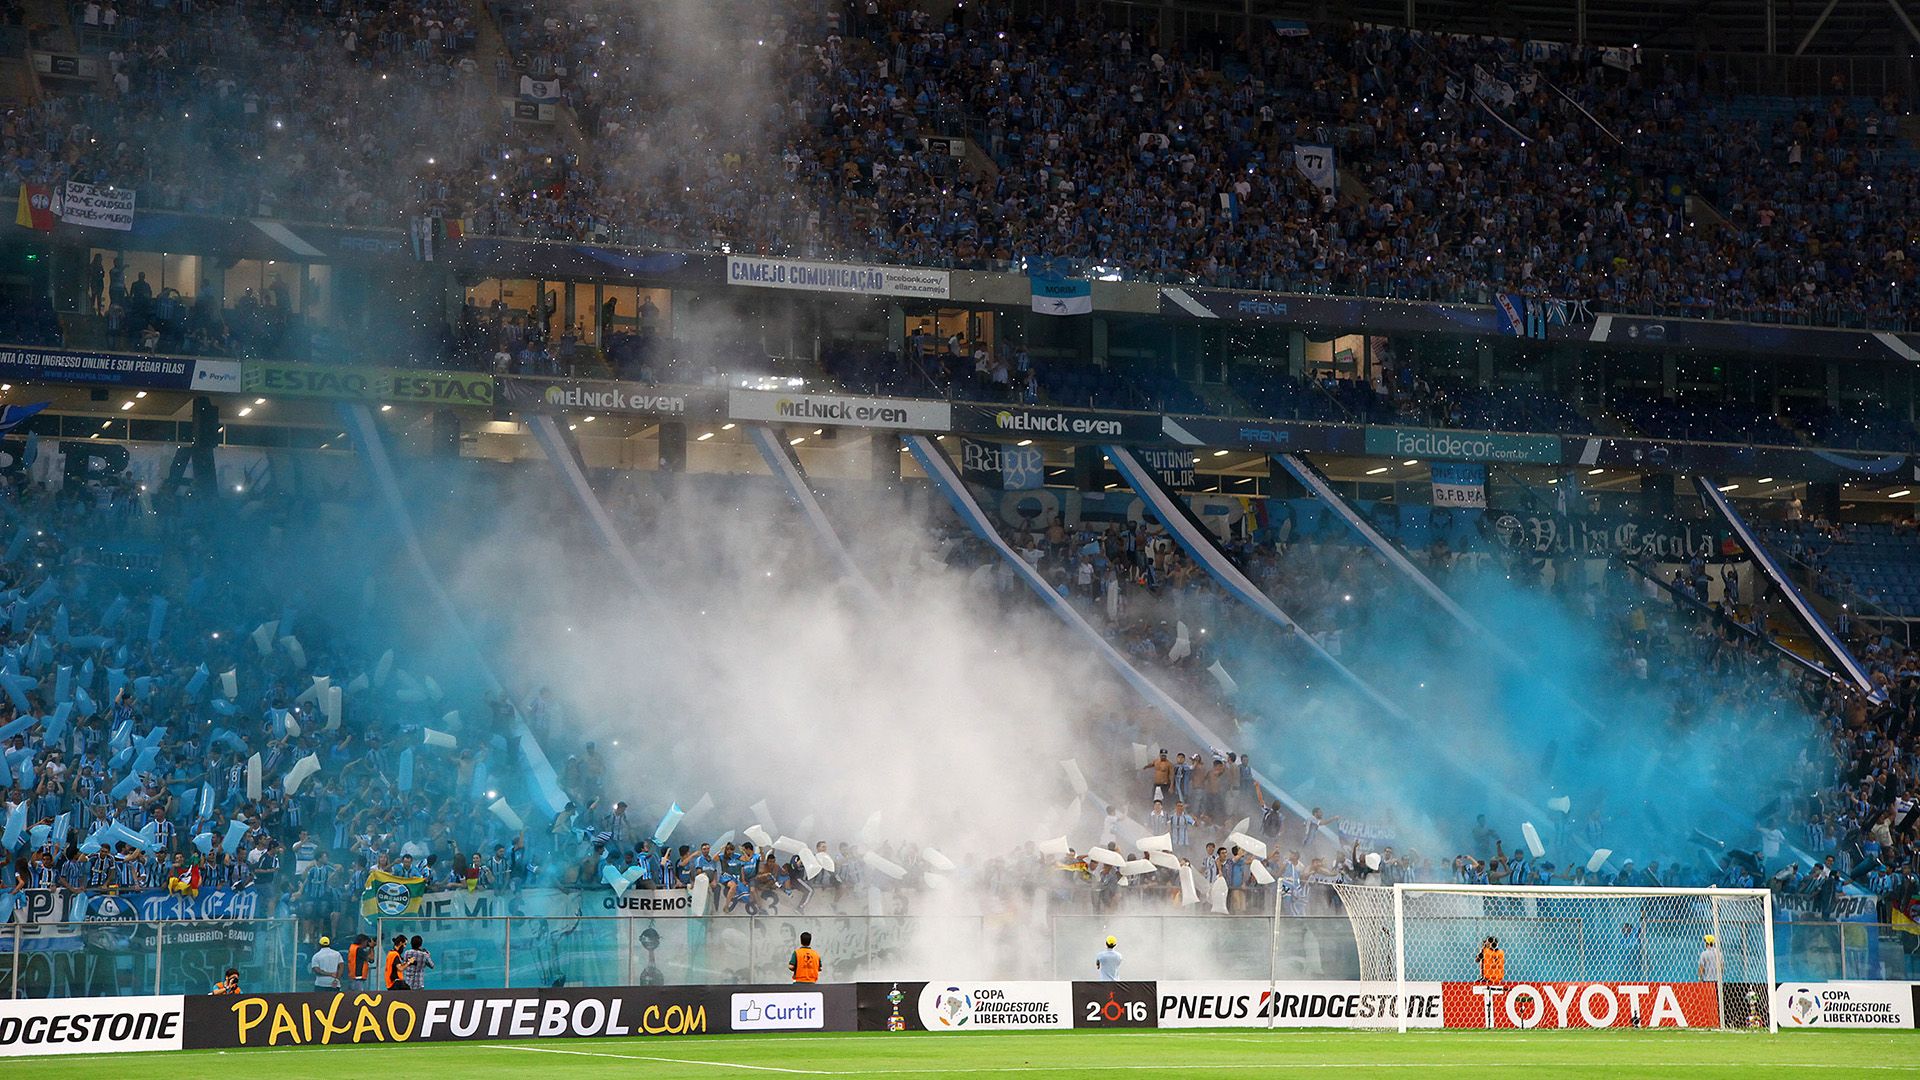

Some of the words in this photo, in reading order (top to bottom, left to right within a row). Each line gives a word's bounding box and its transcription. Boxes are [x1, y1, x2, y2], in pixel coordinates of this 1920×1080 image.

[1304, 155, 1323, 169] 77
[68, 184, 85, 194] SOY
[67, 194, 79, 202] YO
[731, 262, 786, 283] CAMEJO
[790, 266, 883, 292] COMUNICAÇÃO
[1045, 285, 1078, 295] MORIM
[1238, 300, 1287, 315] ARENA
[17, 354, 24, 365] O
[25, 355, 41, 366] SEU
[41, 356, 81, 368] INGRESSO
[82, 359, 109, 370] ONLINE
[110, 360, 116, 370] E
[117, 361, 135, 372] SEM
[135, 362, 160, 373] PEGAR
[162, 362, 185, 374] FILAS!
[265, 369, 368, 394] ESTAQ
[393, 377, 492, 403] ESTAQ
[630, 393, 685, 411] even
[856, 407, 908, 423] even
[1073, 418, 1122, 435] even
[1240, 429, 1289, 442] ARENA
[145, 935, 173, 947] FOTE
[973, 989, 1005, 1000] COPA
[1822, 991, 1850, 1000] COPA
[764, 1002, 816, 1020] Curtir
[974, 1001, 1049, 1013] BRIDGESTONE
[1086, 1000, 1148, 1022] 2016
[1159, 995, 1250, 1019] PNEUS
[1256, 991, 1440, 1019] BRIDGESTONE
[1473, 985, 1688, 1028] TOYOTA
[1824, 1001, 1892, 1013] BRIDGESTONE
[231, 993, 416, 1046] PAIXÃO
[420, 998, 629, 1038] FUTEBOL
[974, 1013, 1059, 1024] LIBERTADORES
[1823, 1013, 1900, 1024] LIBERTADORES
